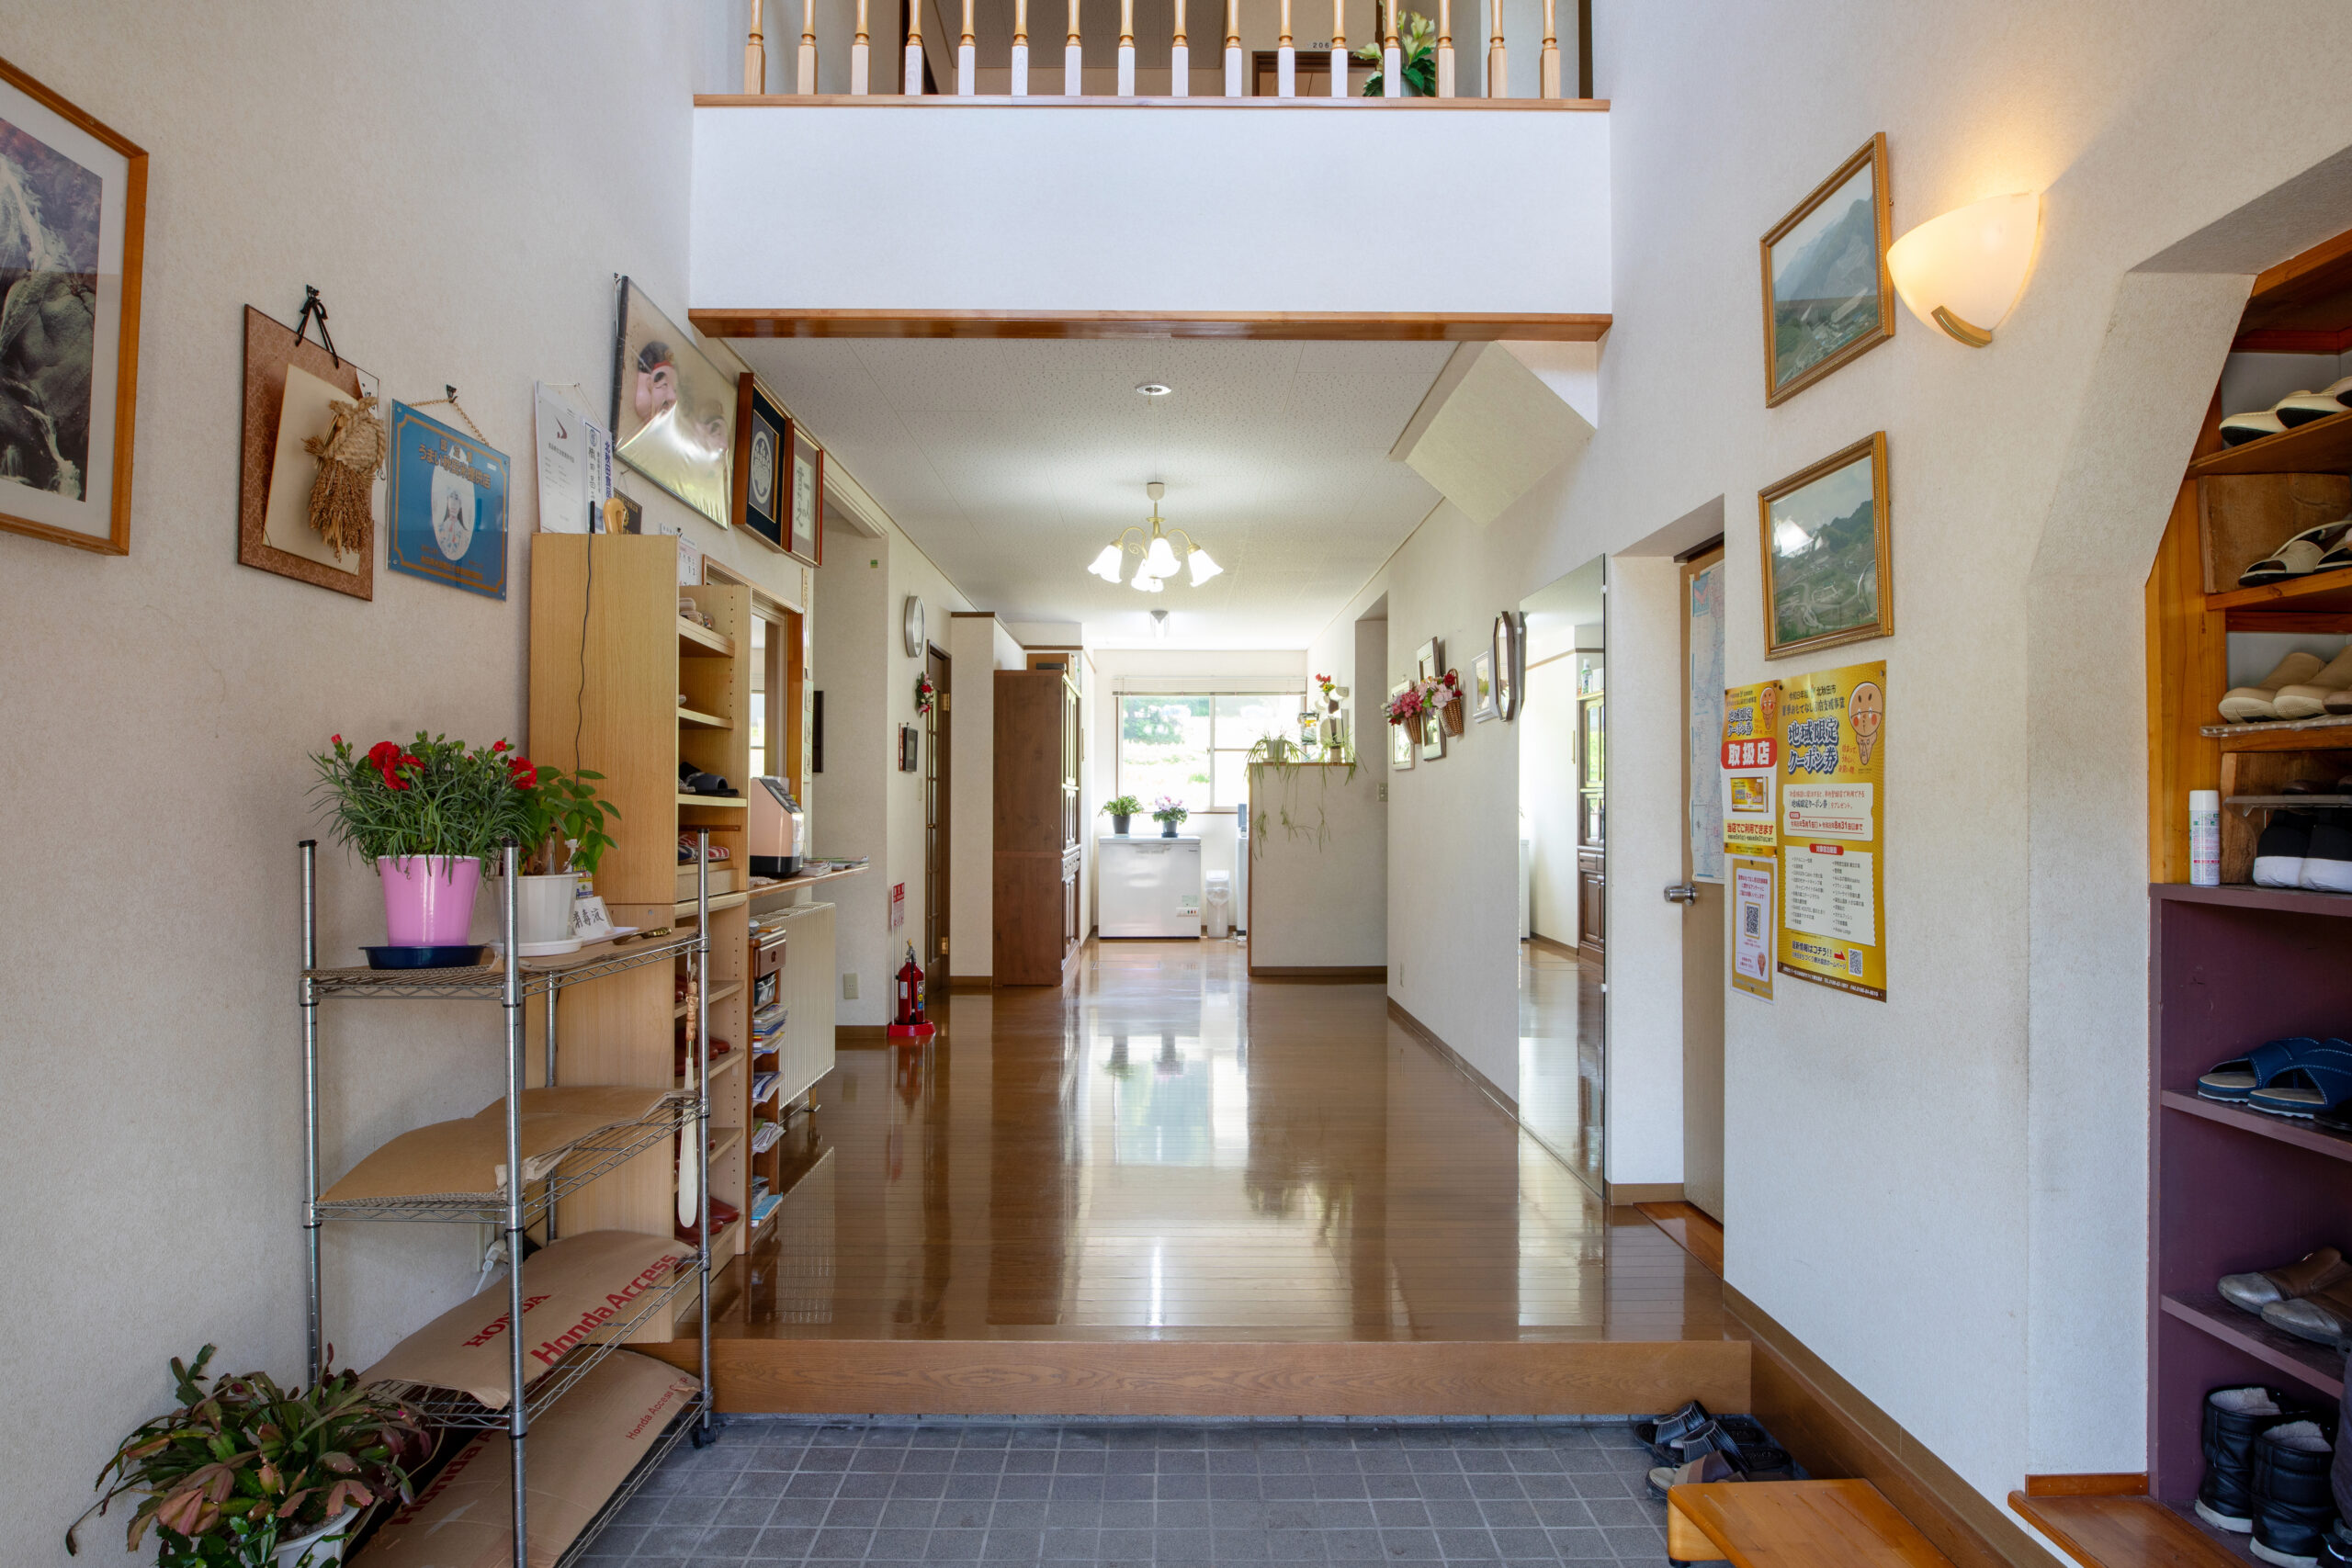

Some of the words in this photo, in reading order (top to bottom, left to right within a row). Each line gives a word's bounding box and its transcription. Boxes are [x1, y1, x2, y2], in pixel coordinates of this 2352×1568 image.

[1816, 684, 1837, 696] 北秋田市
[1788, 716, 1839, 746] 地域限定
[1728, 741, 1770, 766] 取扱店
[1788, 745, 1838, 774] クーポン券
[1727, 822, 1773, 835] 当店でご利用できます
[573, 908, 605, 929] 消毒液
[530, 1306, 610, 1366] Honda
[606, 1254, 679, 1310] Access
[626, 1415, 653, 1441] Honda
[648, 1391, 674, 1416] Access
